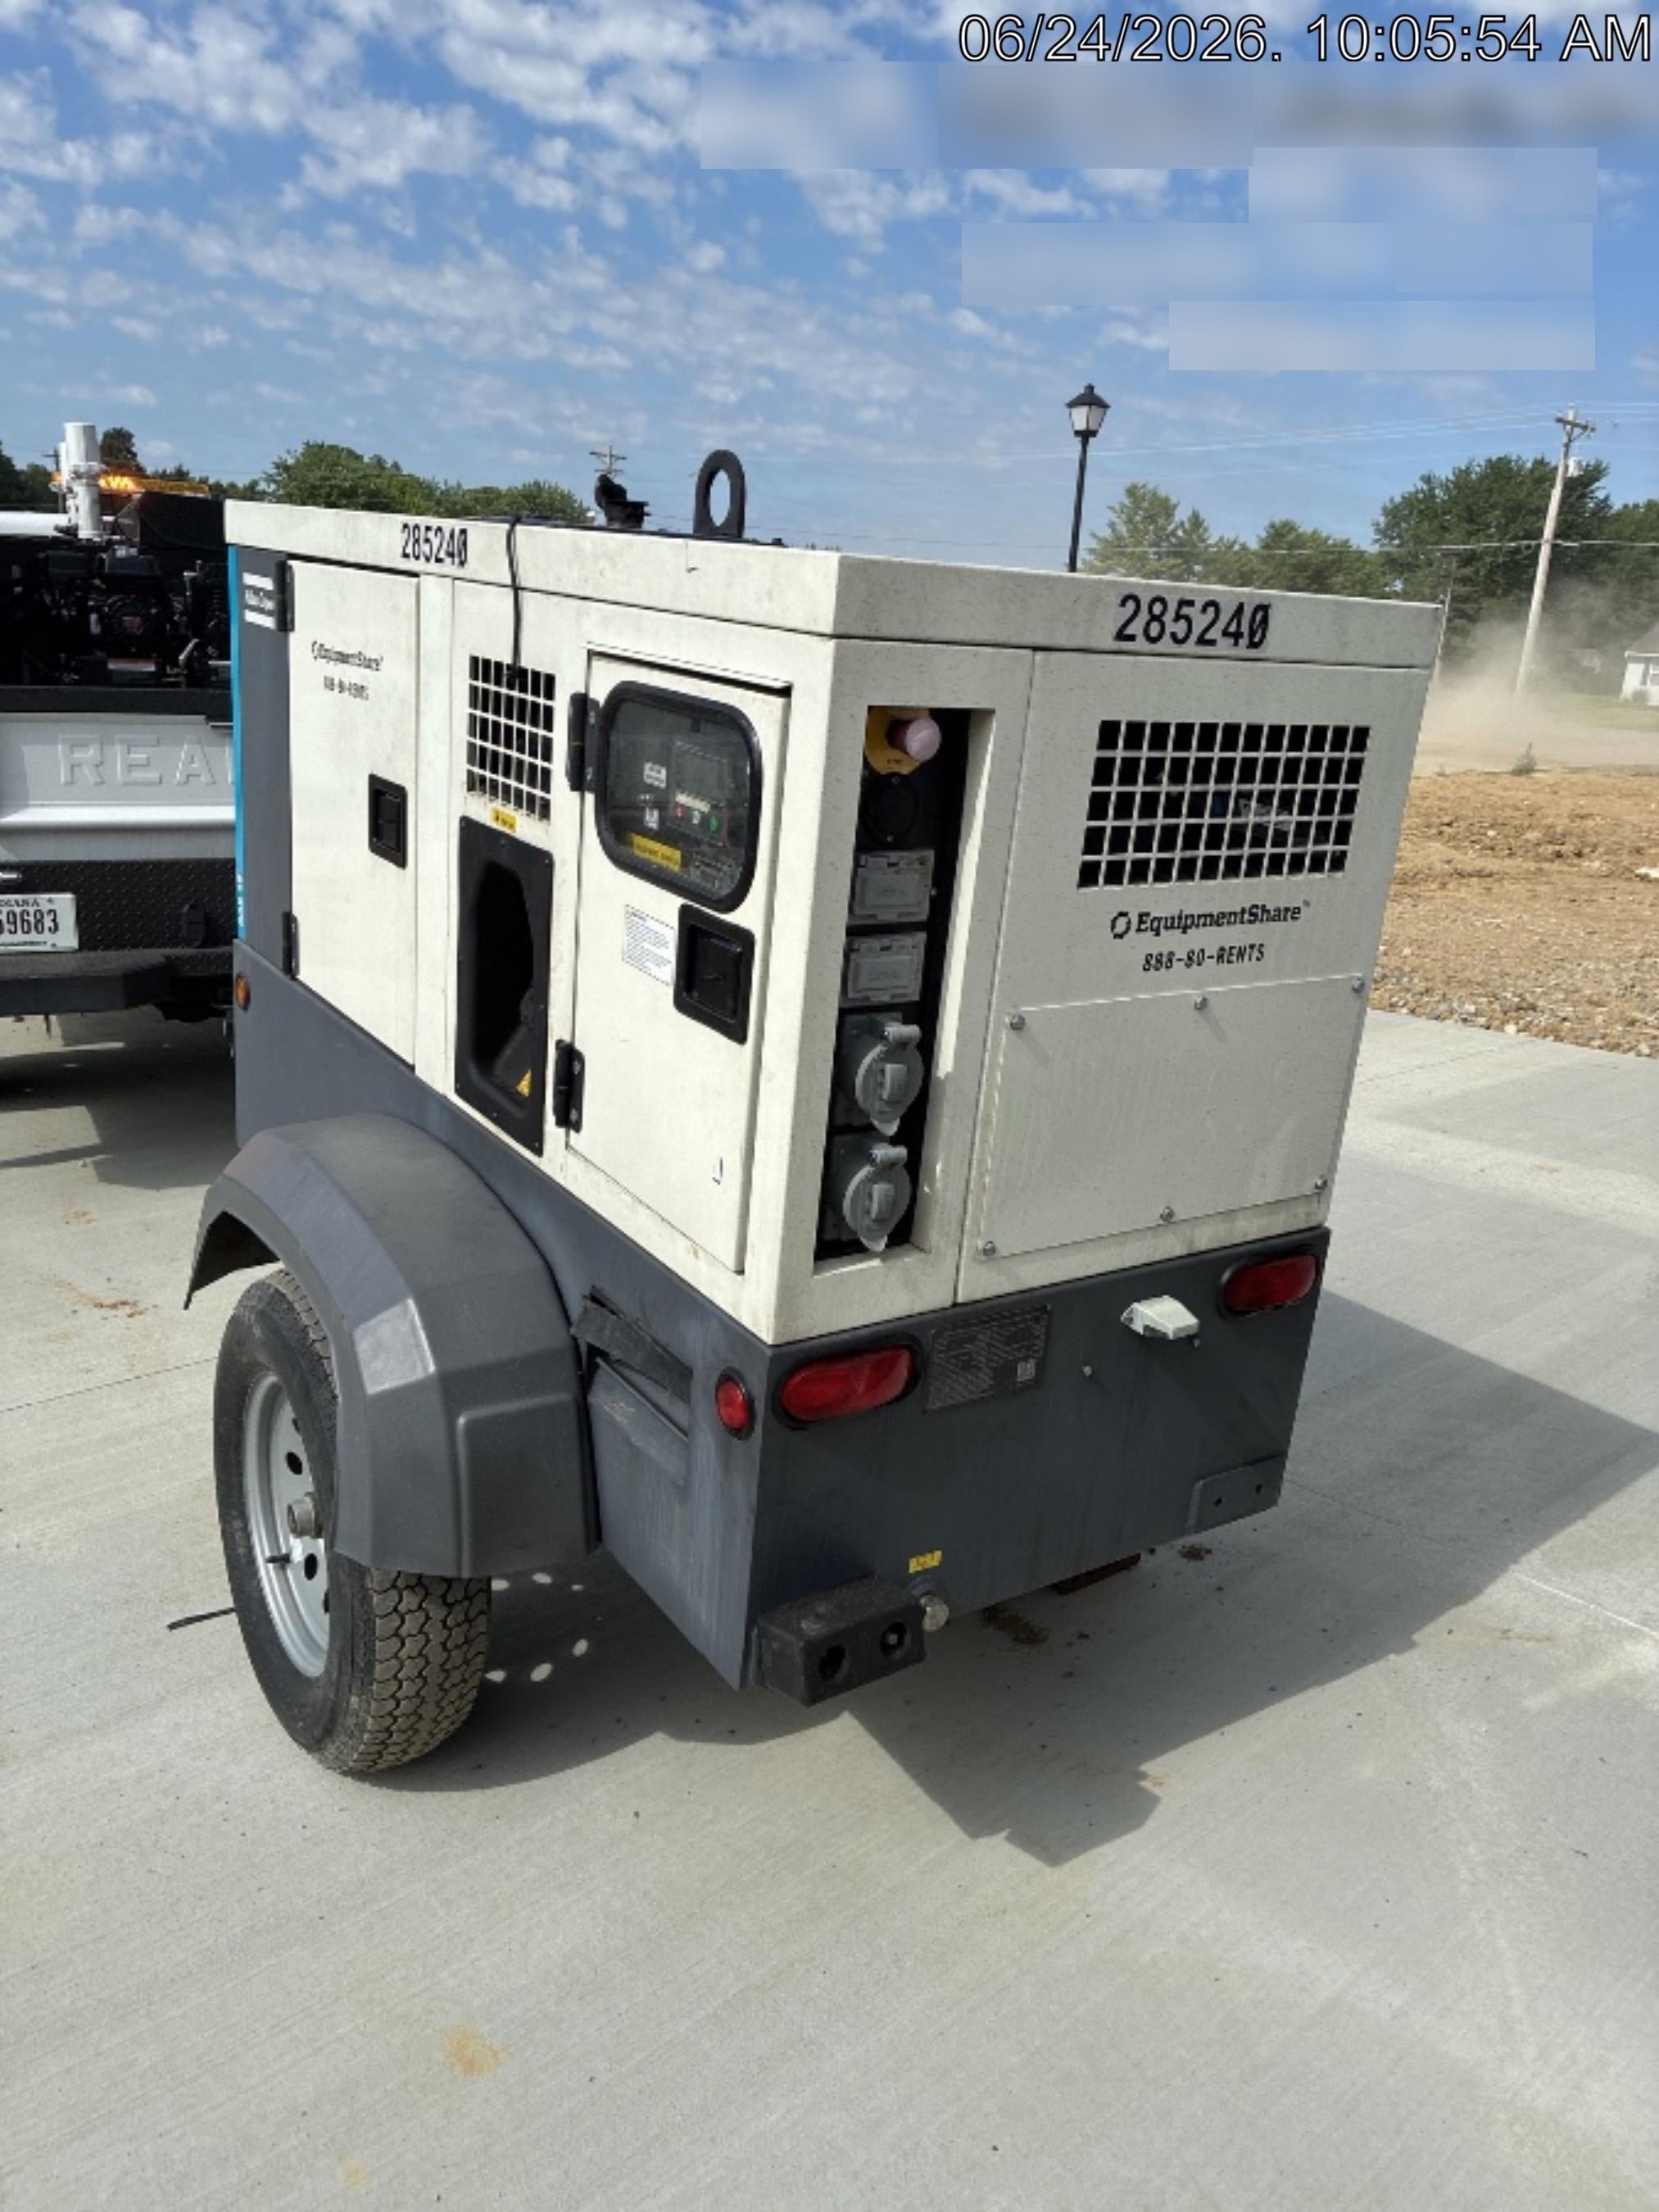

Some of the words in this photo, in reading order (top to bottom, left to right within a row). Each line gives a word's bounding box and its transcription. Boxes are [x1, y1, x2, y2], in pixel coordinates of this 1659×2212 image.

[401, 522, 468, 568] 285240
[1113, 592, 1271, 650] 285240
[58, 735, 234, 785] REA
[1135, 903, 1302, 937] EquipmentShare
[1142, 942, 1266, 972] 888-80-RENTS
